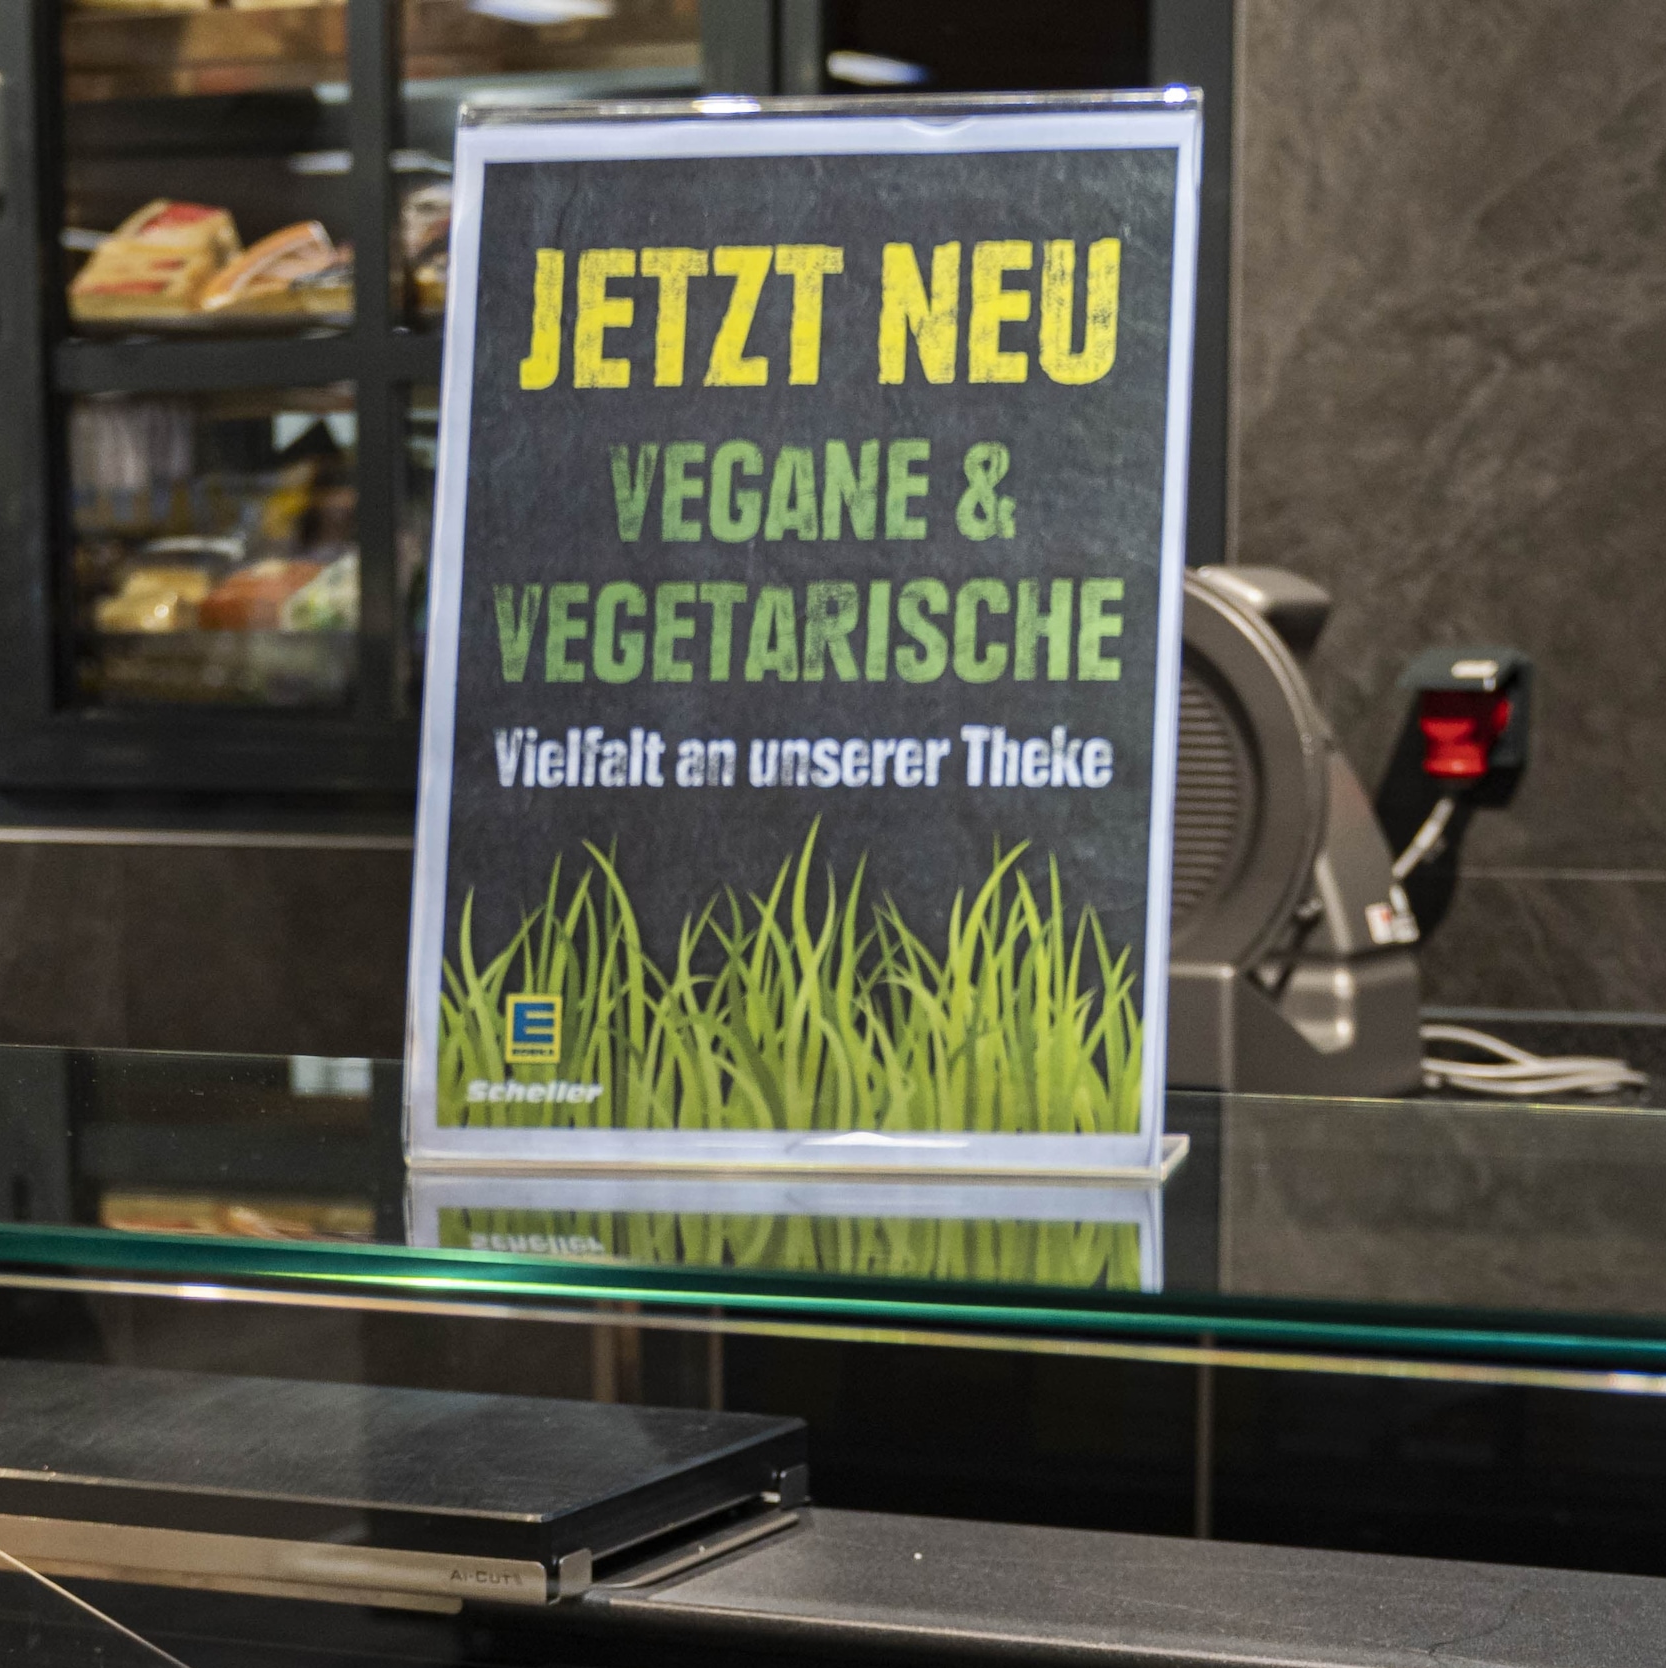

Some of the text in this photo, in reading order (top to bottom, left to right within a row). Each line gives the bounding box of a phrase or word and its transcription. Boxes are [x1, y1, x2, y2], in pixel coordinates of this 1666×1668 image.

[518, 237, 1122, 392] JETZT NEU
[609, 437, 1016, 543] VEGANE &
[492, 577, 1126, 685] VEGETARISCHE
[494, 724, 1114, 790] Vielfalt an unserer Theke
[467, 1079, 604, 1103] Scheller
